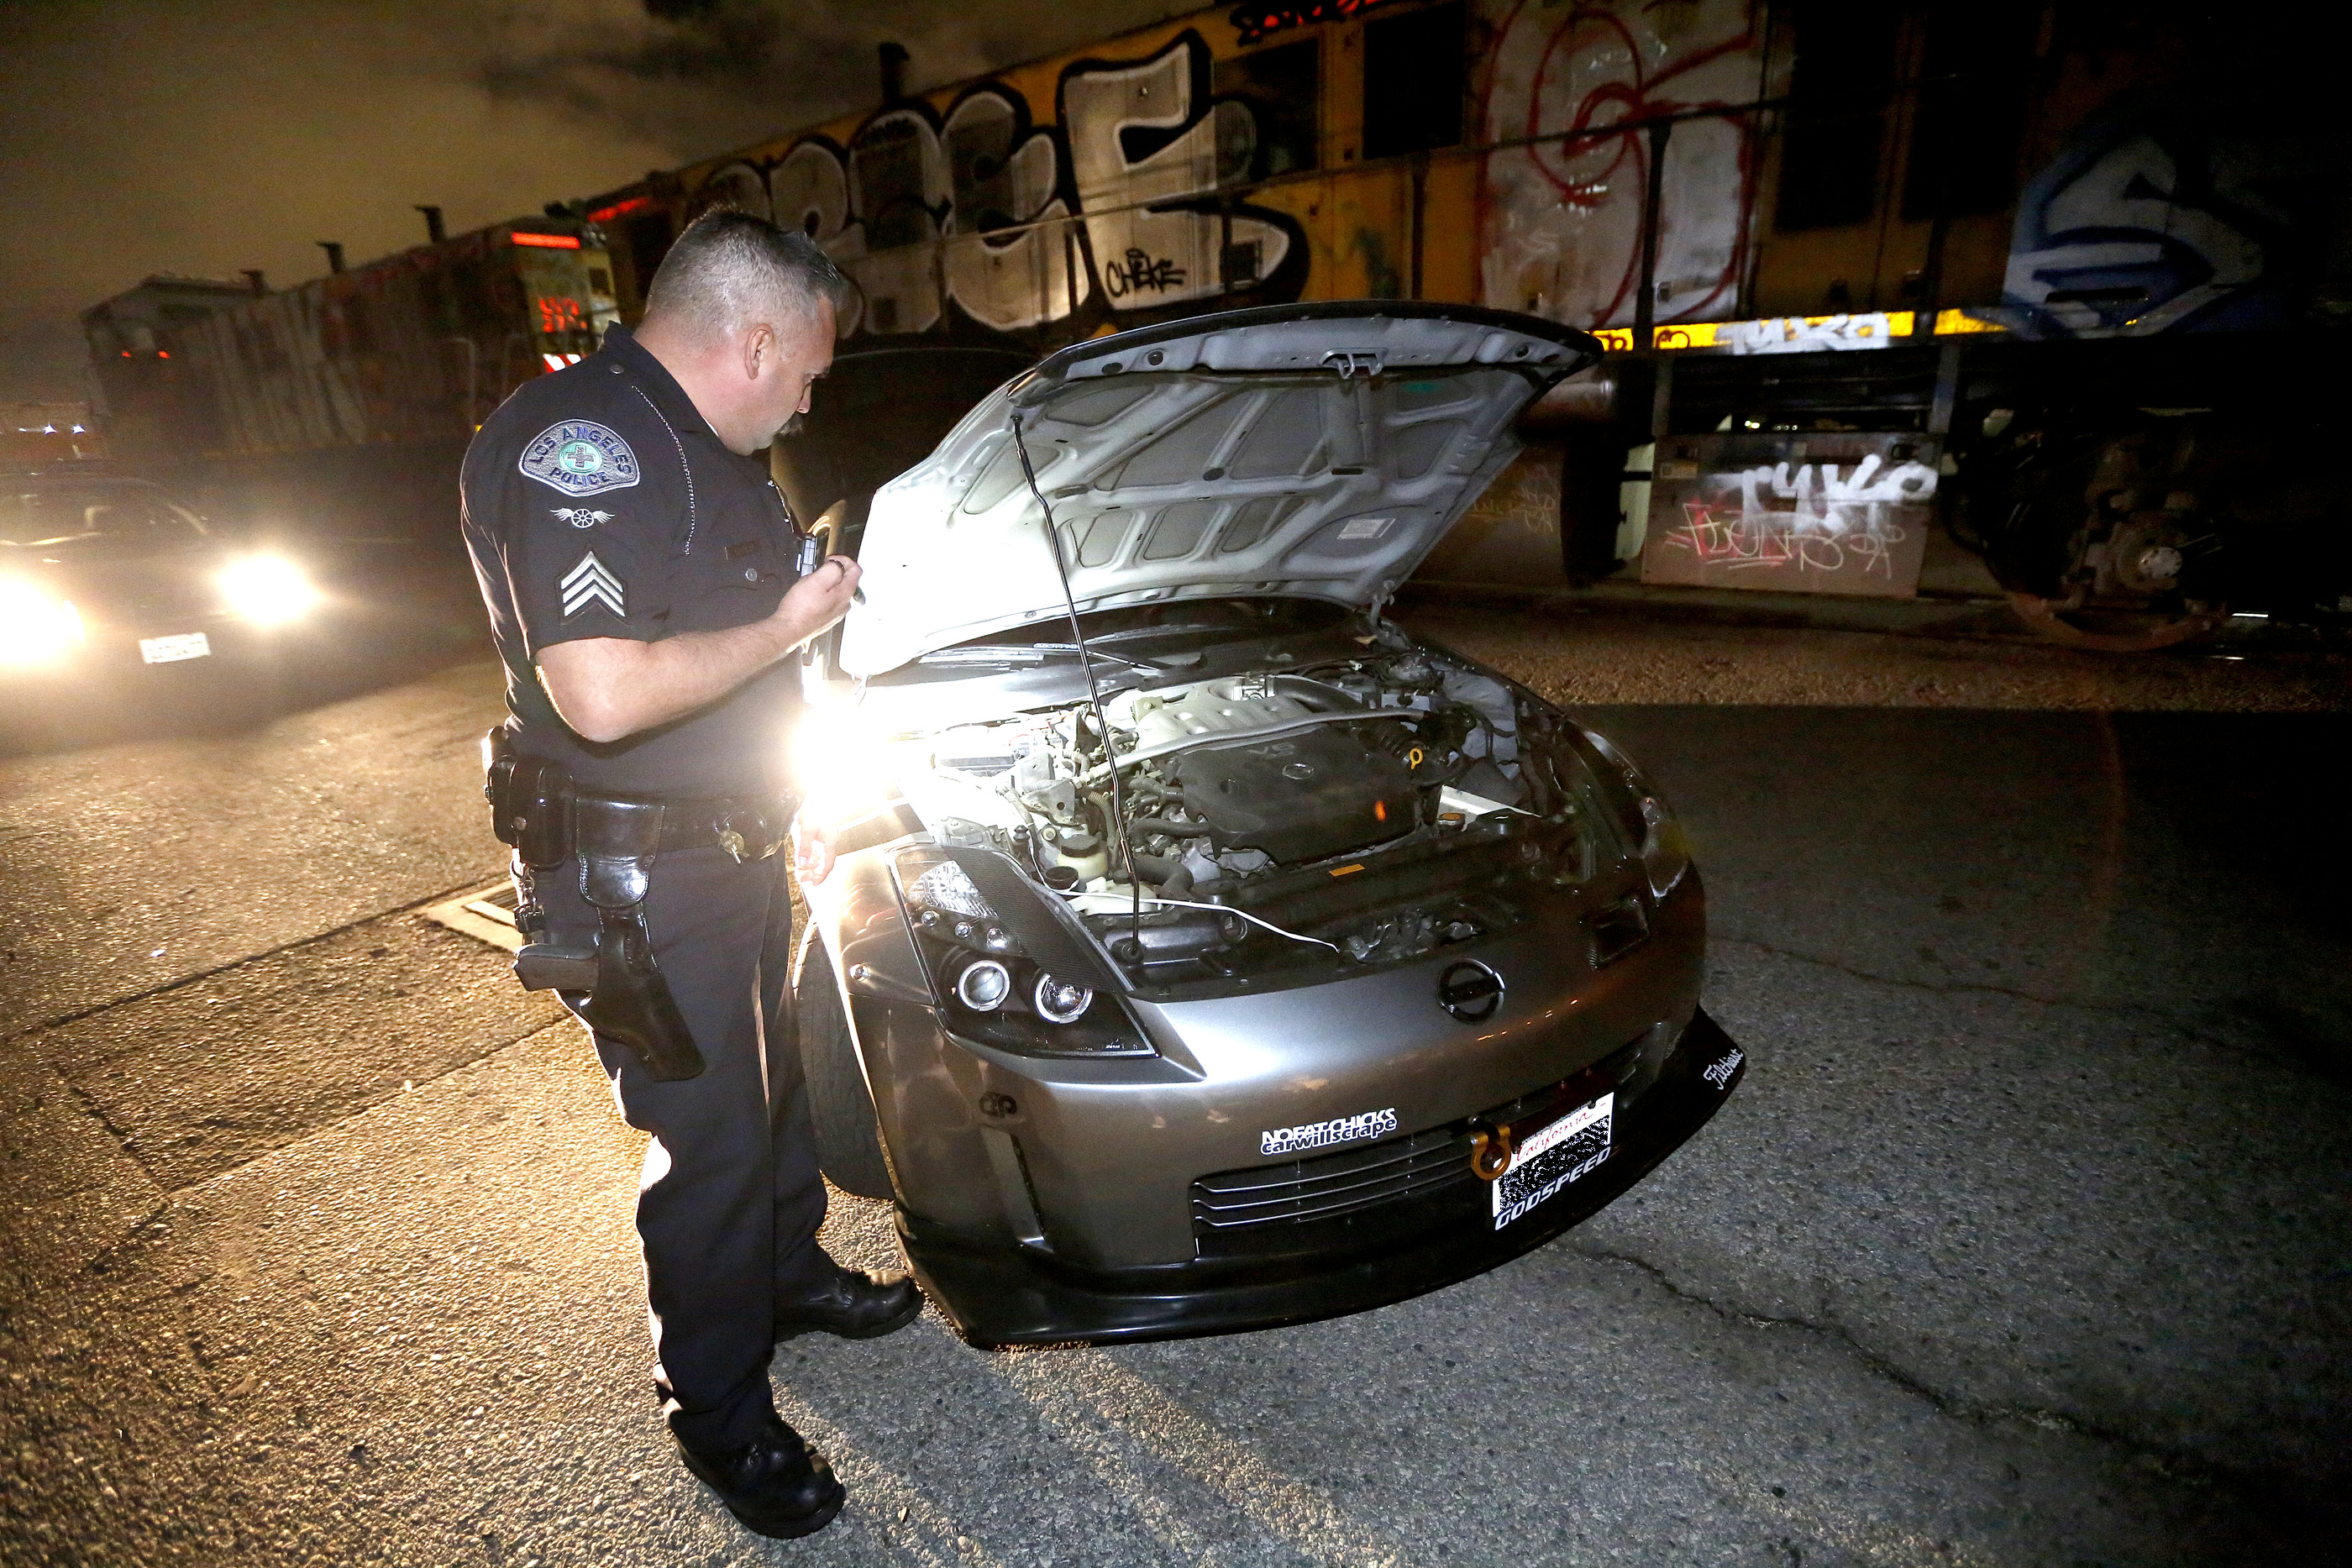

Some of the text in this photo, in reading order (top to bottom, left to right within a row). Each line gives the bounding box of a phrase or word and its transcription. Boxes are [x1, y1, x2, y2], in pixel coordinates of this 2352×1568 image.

[529, 427, 632, 474] LOS ANGELES
[549, 467, 610, 486] POLICE
[1517, 1112, 1594, 1162] California
[1494, 1146, 1611, 1231] GODSPEED
